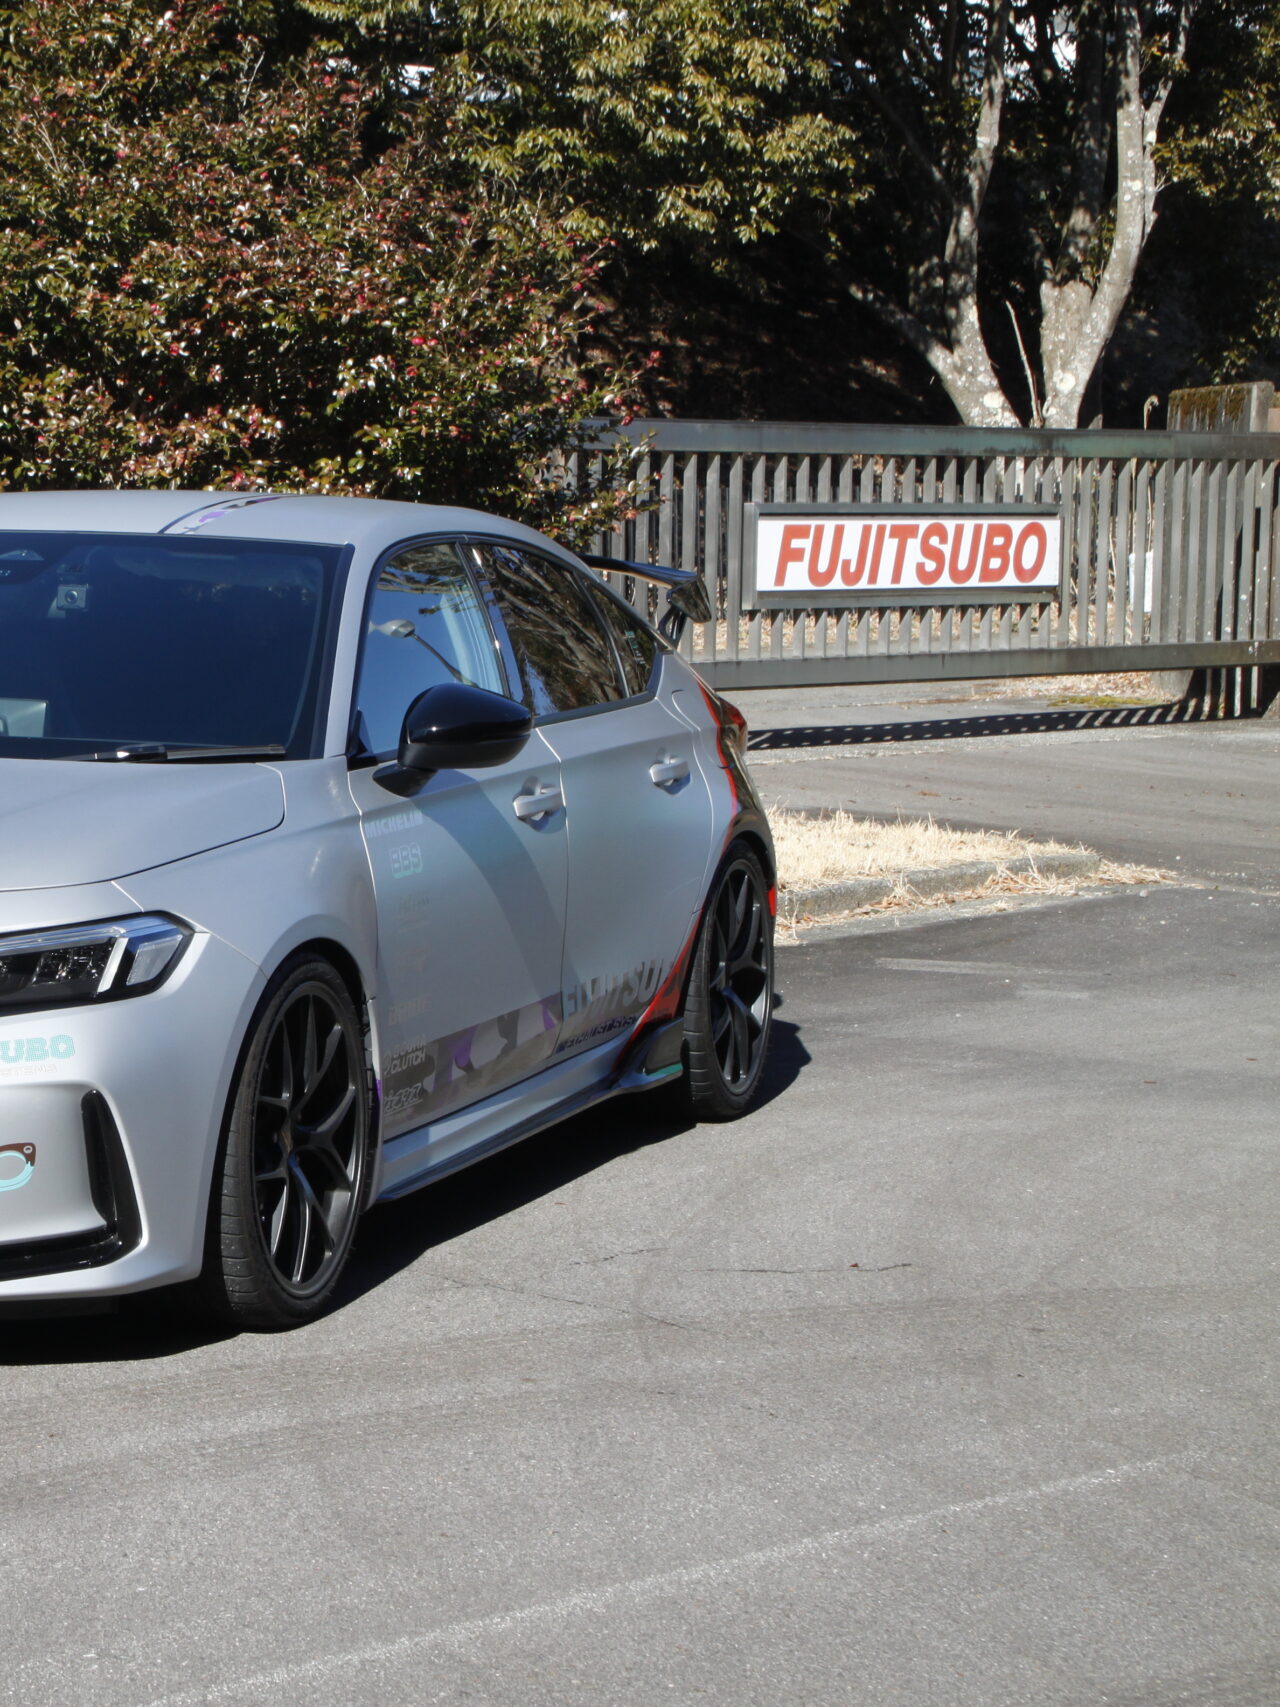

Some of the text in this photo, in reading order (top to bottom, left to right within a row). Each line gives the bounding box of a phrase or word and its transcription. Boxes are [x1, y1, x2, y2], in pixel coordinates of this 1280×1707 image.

[773, 521, 1048, 588] FUJITSUBO
[364, 810, 424, 838] MICHELIN
[390, 1049, 426, 1074] CLUTCH
